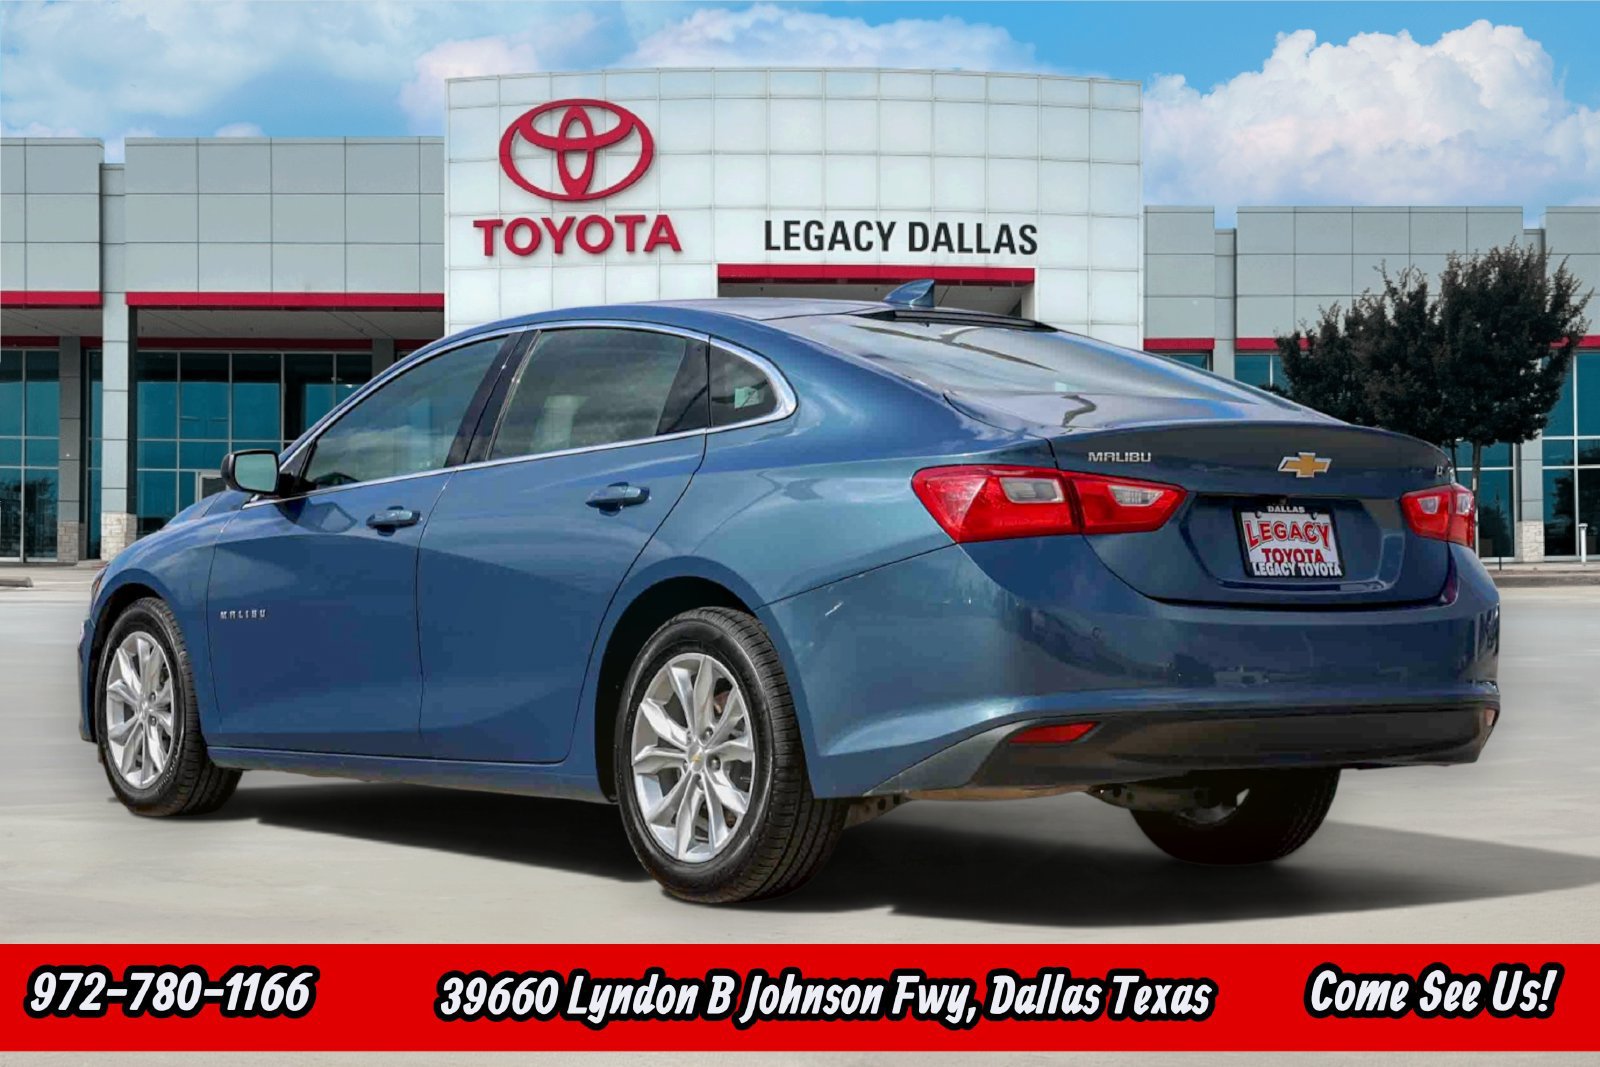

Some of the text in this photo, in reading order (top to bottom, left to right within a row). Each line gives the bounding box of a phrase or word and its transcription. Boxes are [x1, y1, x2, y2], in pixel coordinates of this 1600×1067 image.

[473, 214, 682, 257] TOYOTA
[764, 219, 1038, 256] LEGACY DALLAS
[1088, 451, 1152, 463] MALIBU
[1266, 505, 1306, 513] DALLAS
[1243, 520, 1331, 551] LEGACY
[1261, 548, 1325, 564] TOYOTA
[1252, 562, 1342, 576] LEGACY TOYOTA
[220, 609, 266, 619] MALIBU
